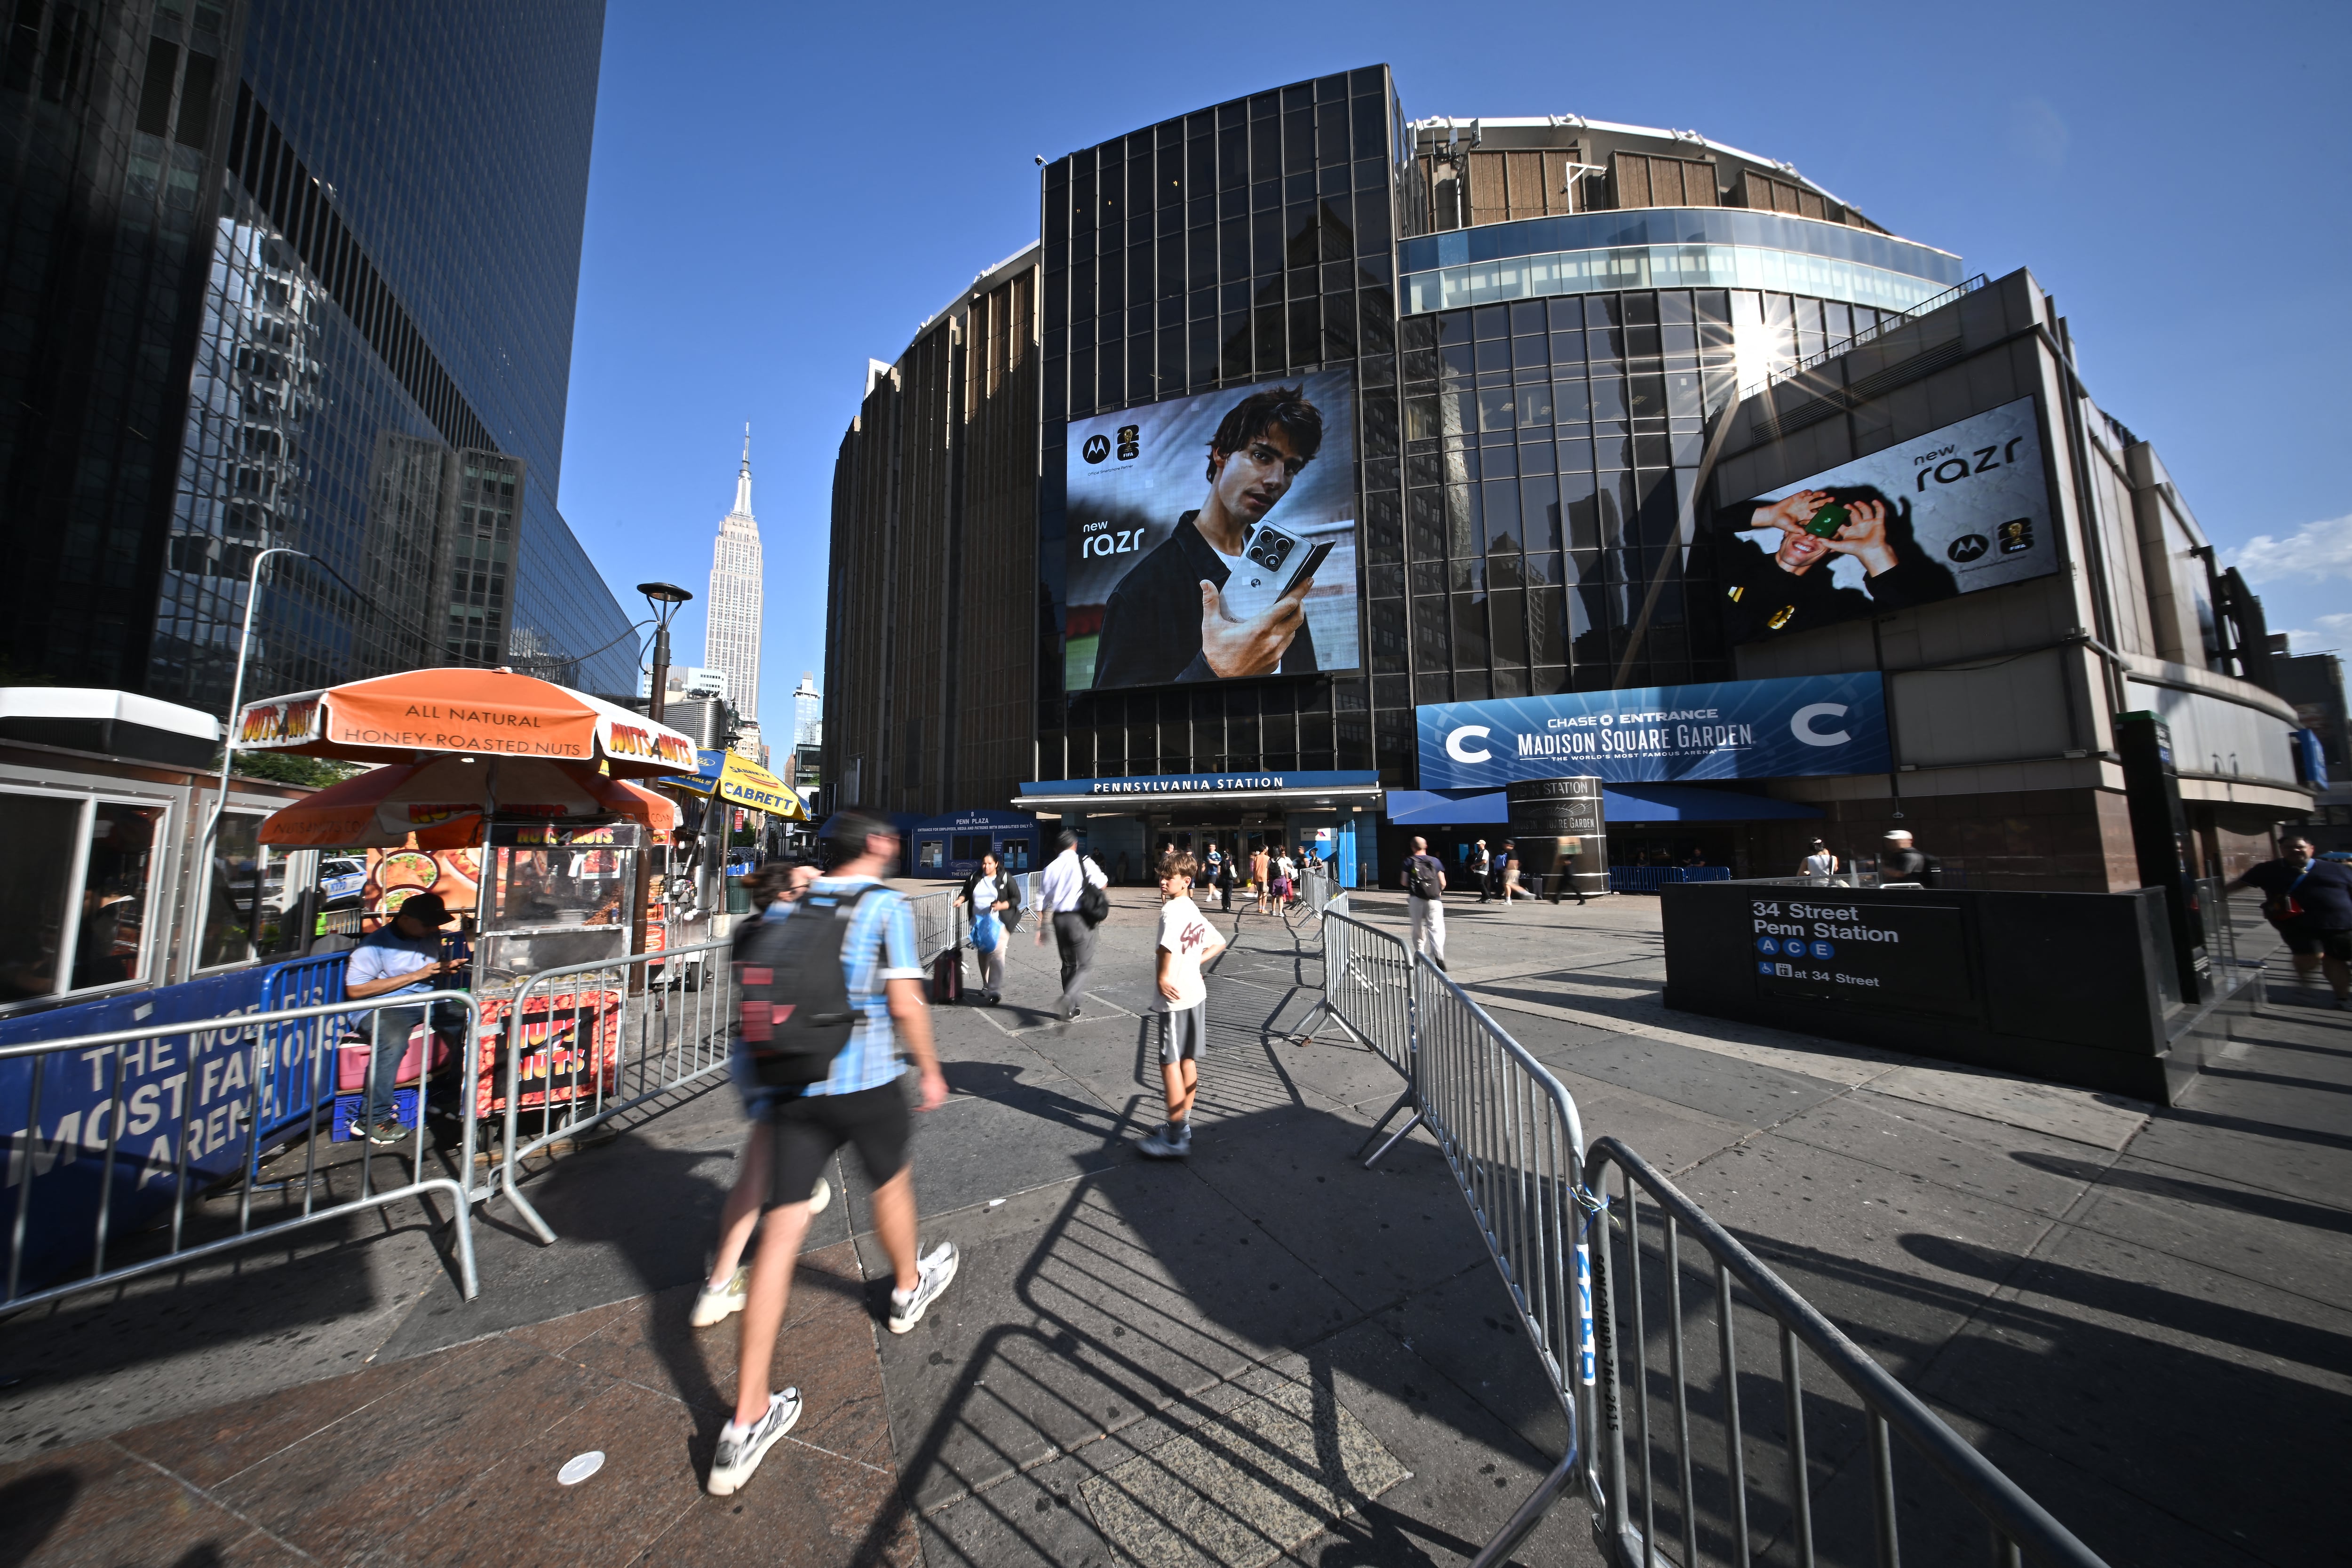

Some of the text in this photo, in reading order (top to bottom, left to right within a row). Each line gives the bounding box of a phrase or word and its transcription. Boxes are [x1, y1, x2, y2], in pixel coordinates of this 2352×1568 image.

[1914, 444, 1955, 466] new
[1917, 436, 2023, 493] razr
[1083, 520, 1108, 533] new
[1083, 528, 1144, 558] razr
[405, 705, 540, 728] ALL NATURAL
[1548, 708, 1718, 728] CHASE ENTRANCE
[1791, 702, 1851, 747] C
[345, 729, 580, 756] HONEY-ROASTED NUTS
[1446, 725, 1492, 763] C
[1518, 724, 1752, 756] MADISON SQUARE GARDEN
[729, 766, 771, 778] SABRETT
[724, 782, 793, 810] SABRETT
[1094, 777, 1283, 792] PENNSYLVANIA STATION
[1543, 781, 1588, 795] STATION
[1569, 817, 1594, 828] GARDEN
[1753, 902, 1859, 921] 34 Street
[1754, 919, 1899, 943] Penn Station
[1763, 940, 1828, 955] A C E
[1795, 970, 1880, 987] at 34 Street
[81, 1037, 175, 1092] THE
[6, 1072, 187, 1188] MOST
[1577, 1251, 1595, 1379] NYPD
